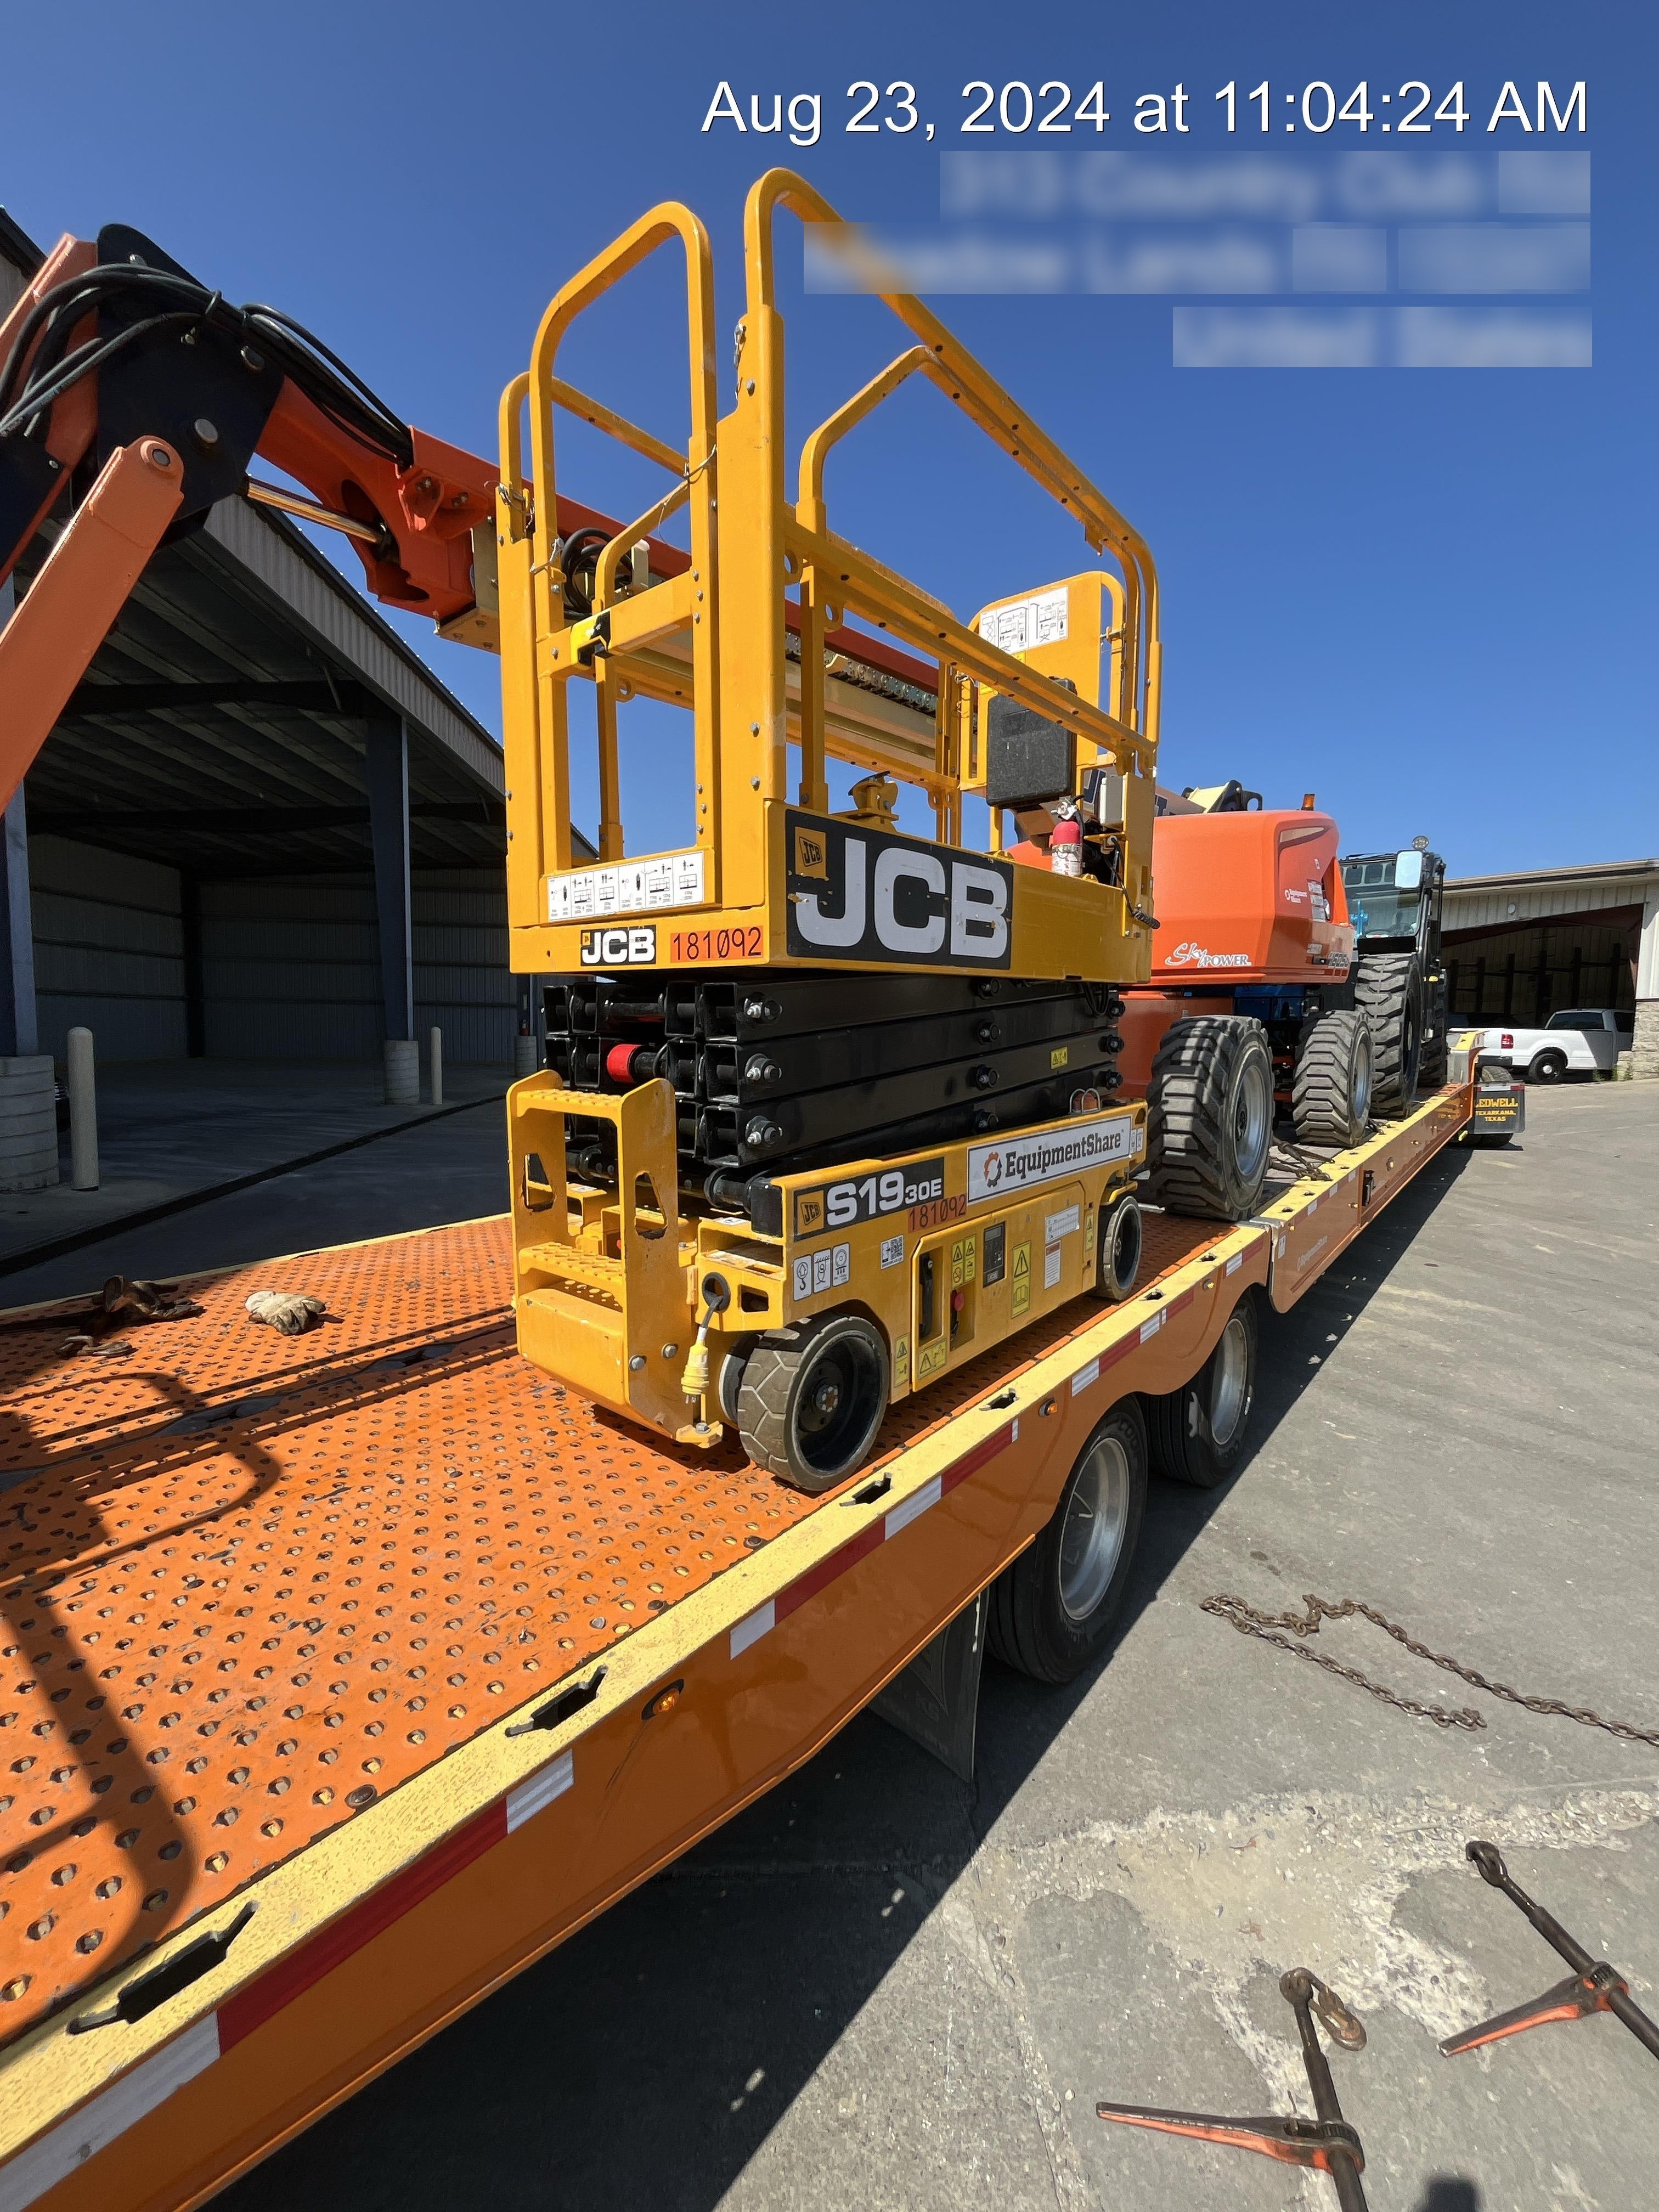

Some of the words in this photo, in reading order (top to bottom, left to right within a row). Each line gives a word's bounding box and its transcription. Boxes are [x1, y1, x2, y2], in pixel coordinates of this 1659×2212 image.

[802, 840, 821, 865] JCB
[795, 837, 1008, 959] JCB
[582, 928, 656, 964] JCB
[673, 926, 761, 961] 181092
[1005, 1132, 1121, 1180] EquipmentShare
[803, 1203, 821, 1224] JCB
[909, 1193, 967, 1231] 181092
